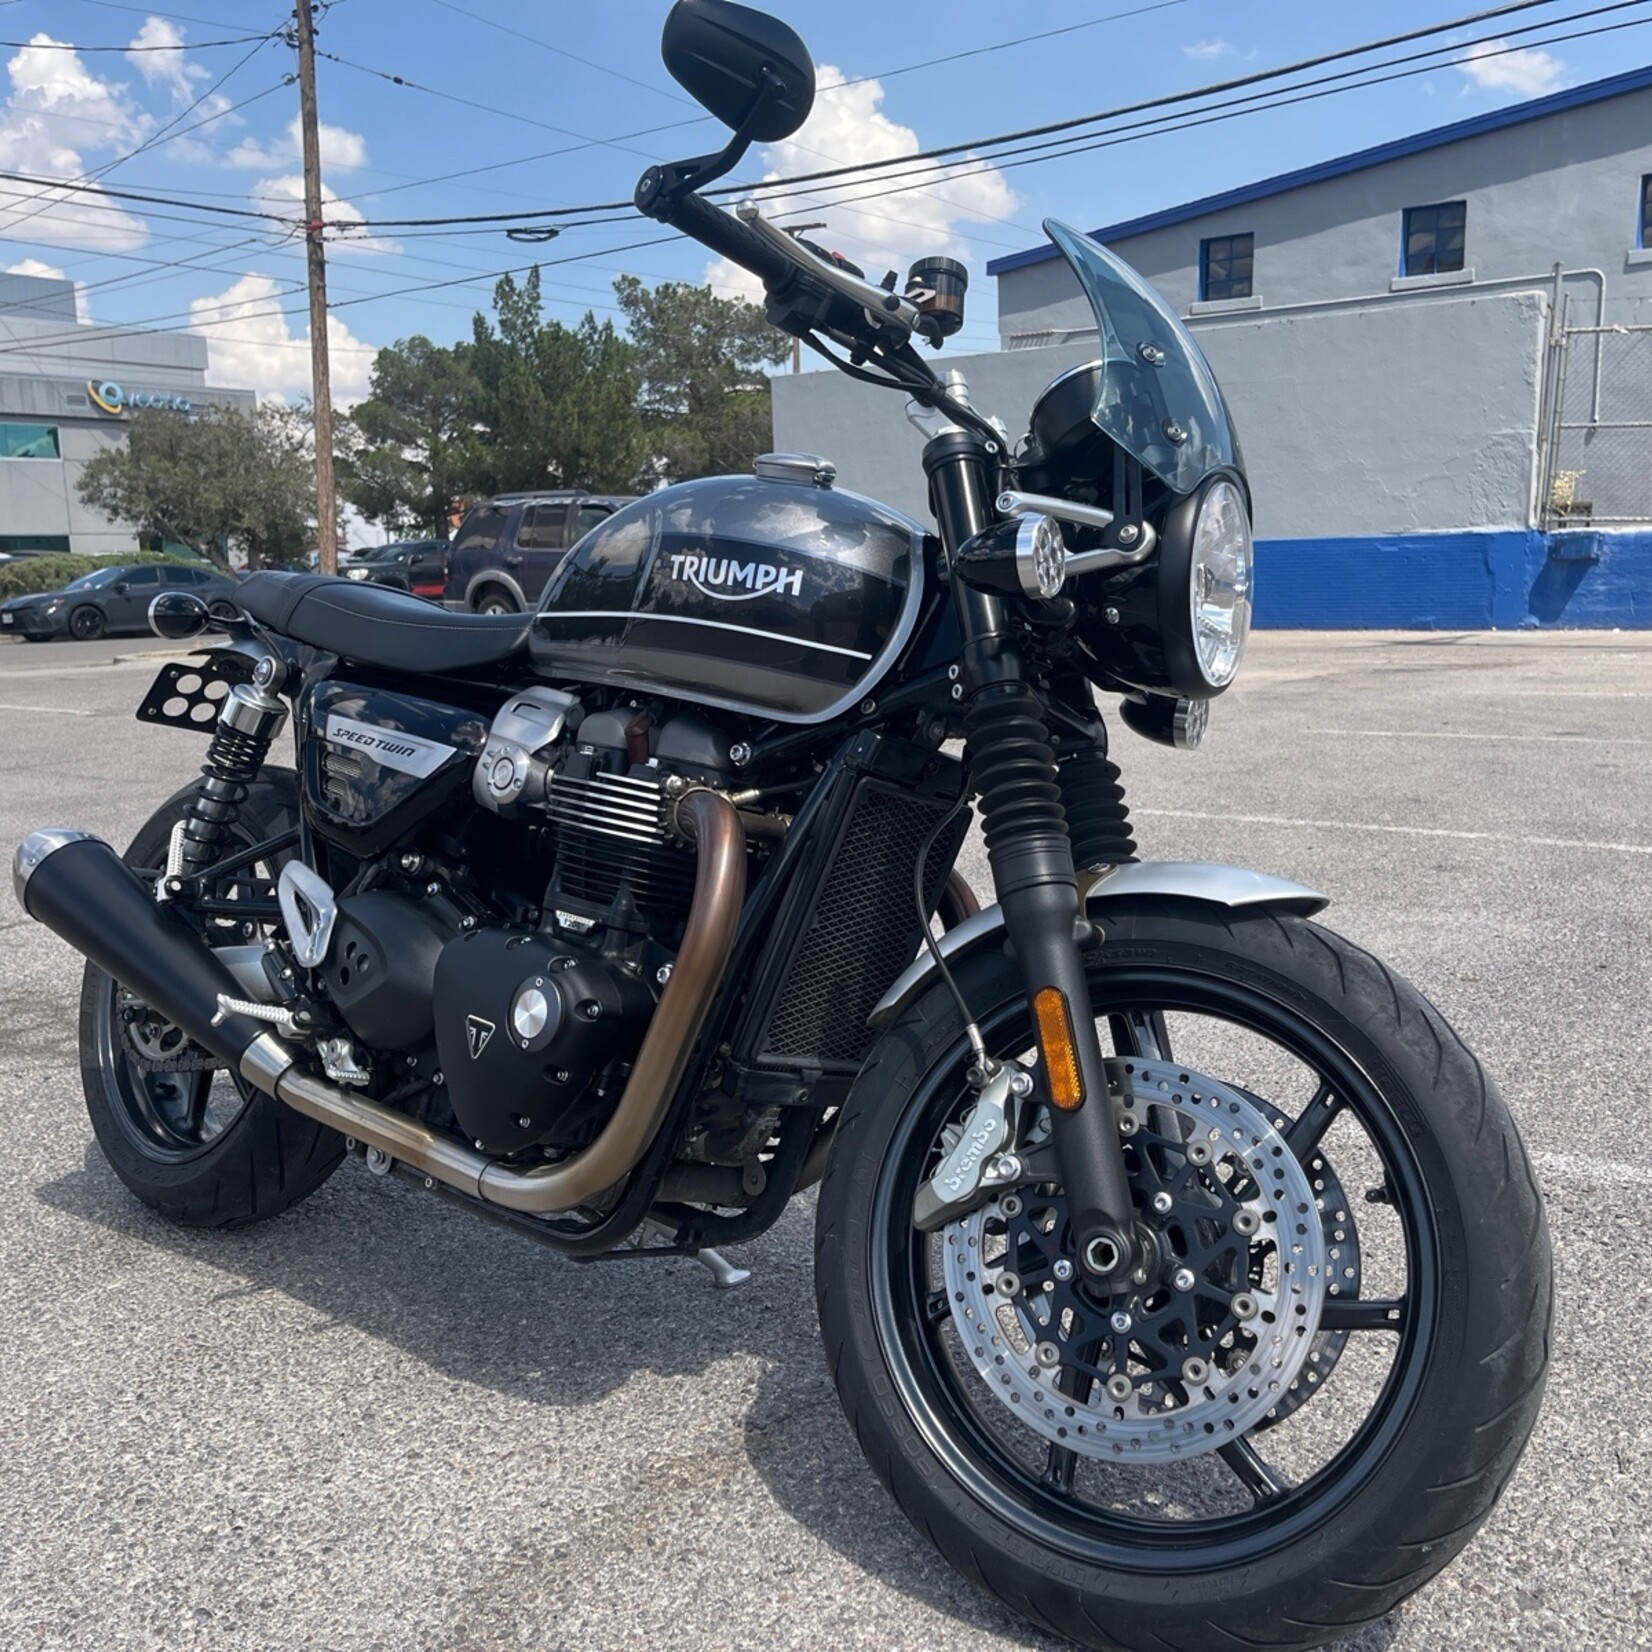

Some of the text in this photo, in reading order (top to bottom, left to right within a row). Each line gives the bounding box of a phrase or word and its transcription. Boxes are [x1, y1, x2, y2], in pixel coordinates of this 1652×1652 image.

[670, 554, 804, 600] TRIUMPH
[333, 727, 416, 757] SPEED TWIN
[944, 1118, 997, 1192] brembo
